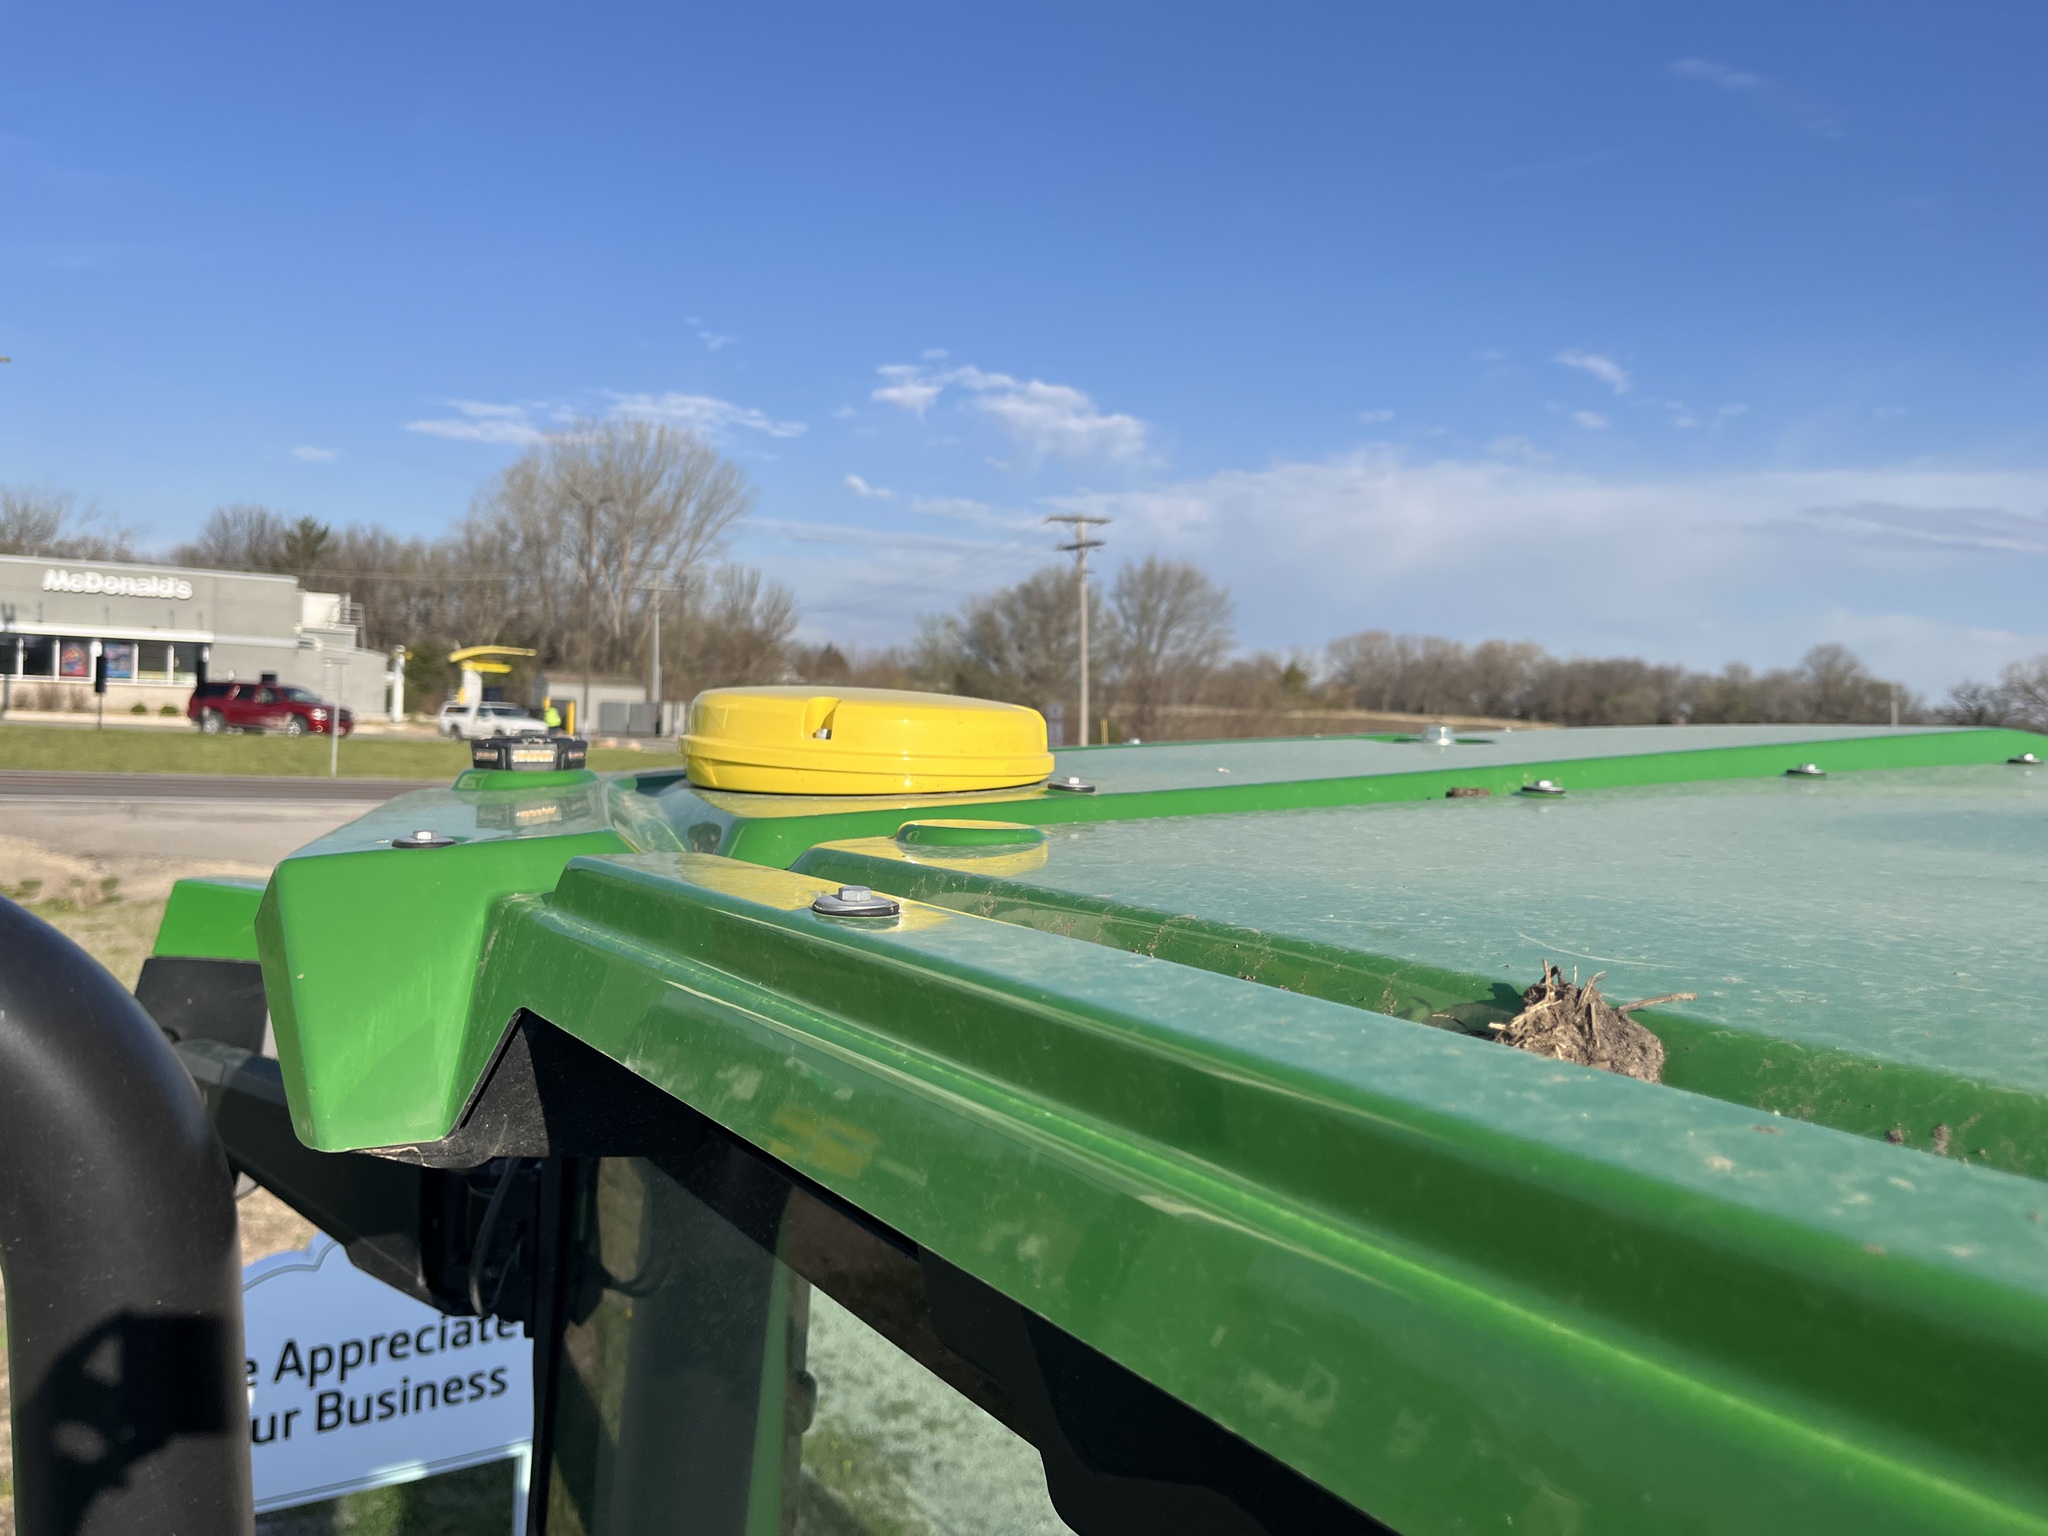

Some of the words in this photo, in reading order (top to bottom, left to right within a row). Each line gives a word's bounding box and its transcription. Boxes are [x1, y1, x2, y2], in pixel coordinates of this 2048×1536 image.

[43, 569, 193, 600] McDonald's
[251, 1408, 300, 1444] ur
[316, 1365, 508, 1433] Business
